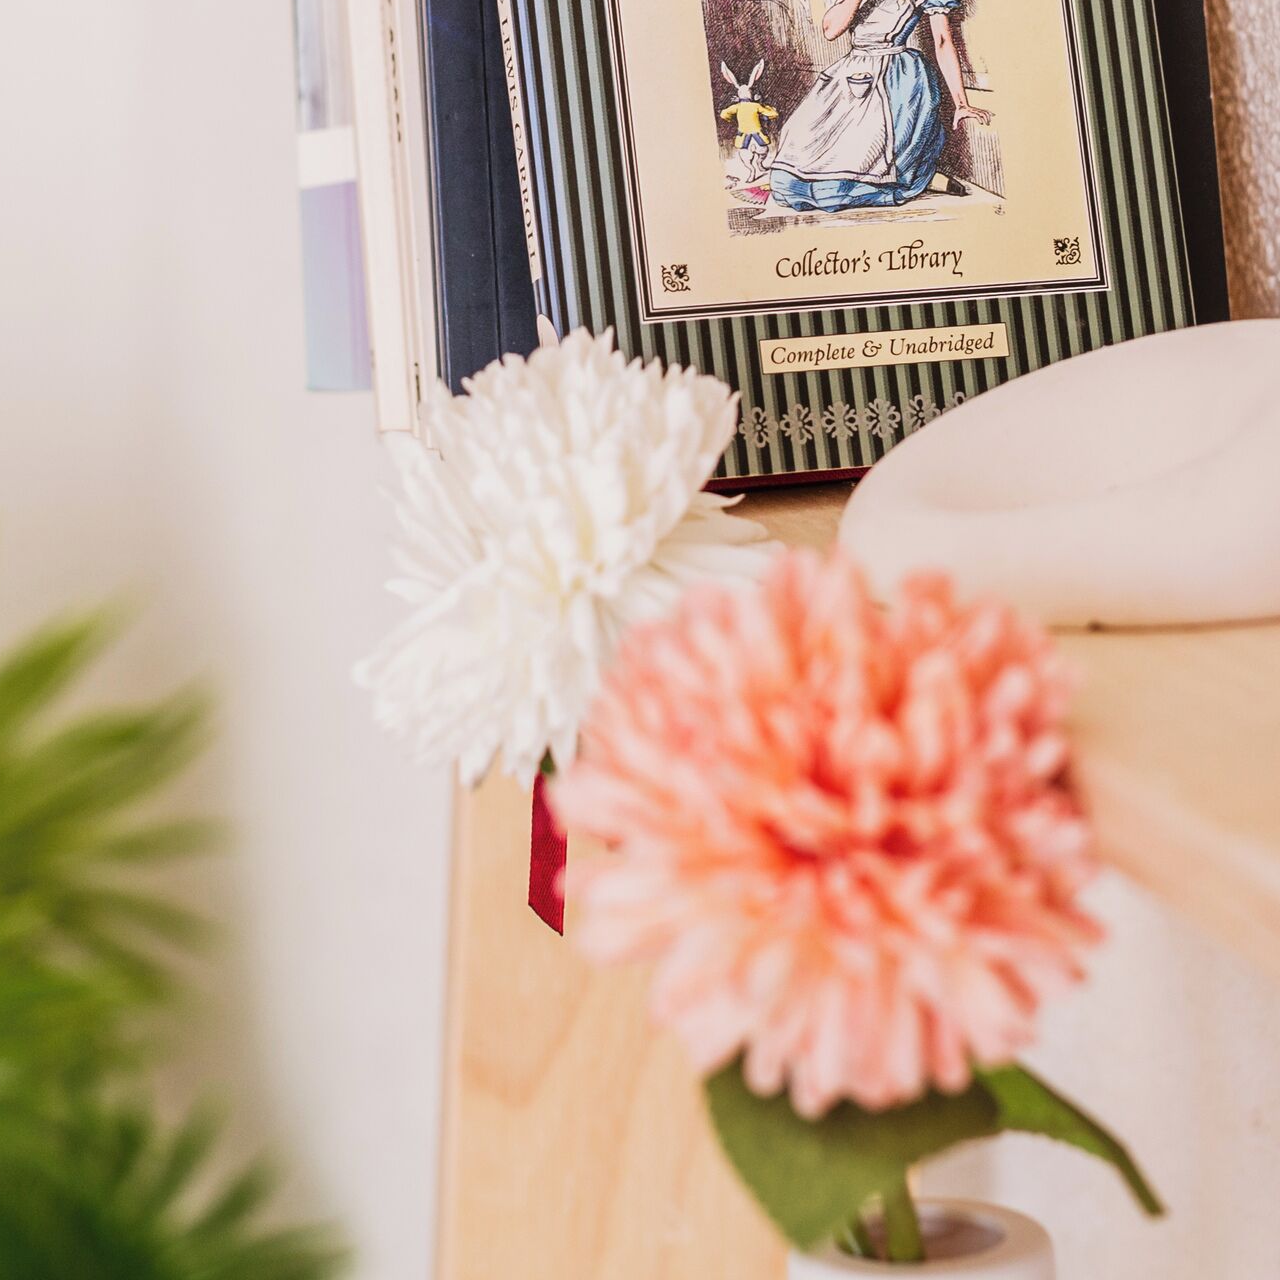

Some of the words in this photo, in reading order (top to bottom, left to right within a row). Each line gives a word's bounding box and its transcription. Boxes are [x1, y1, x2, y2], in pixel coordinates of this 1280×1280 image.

[502, 17, 518, 112] LEWIS
[515, 123, 536, 269] CARROLL
[775, 247, 871, 279] Collector's
[878, 239, 963, 278] Library
[770, 344, 856, 367] Complete
[862, 340, 883, 358] &
[889, 331, 995, 356] Unabridged
